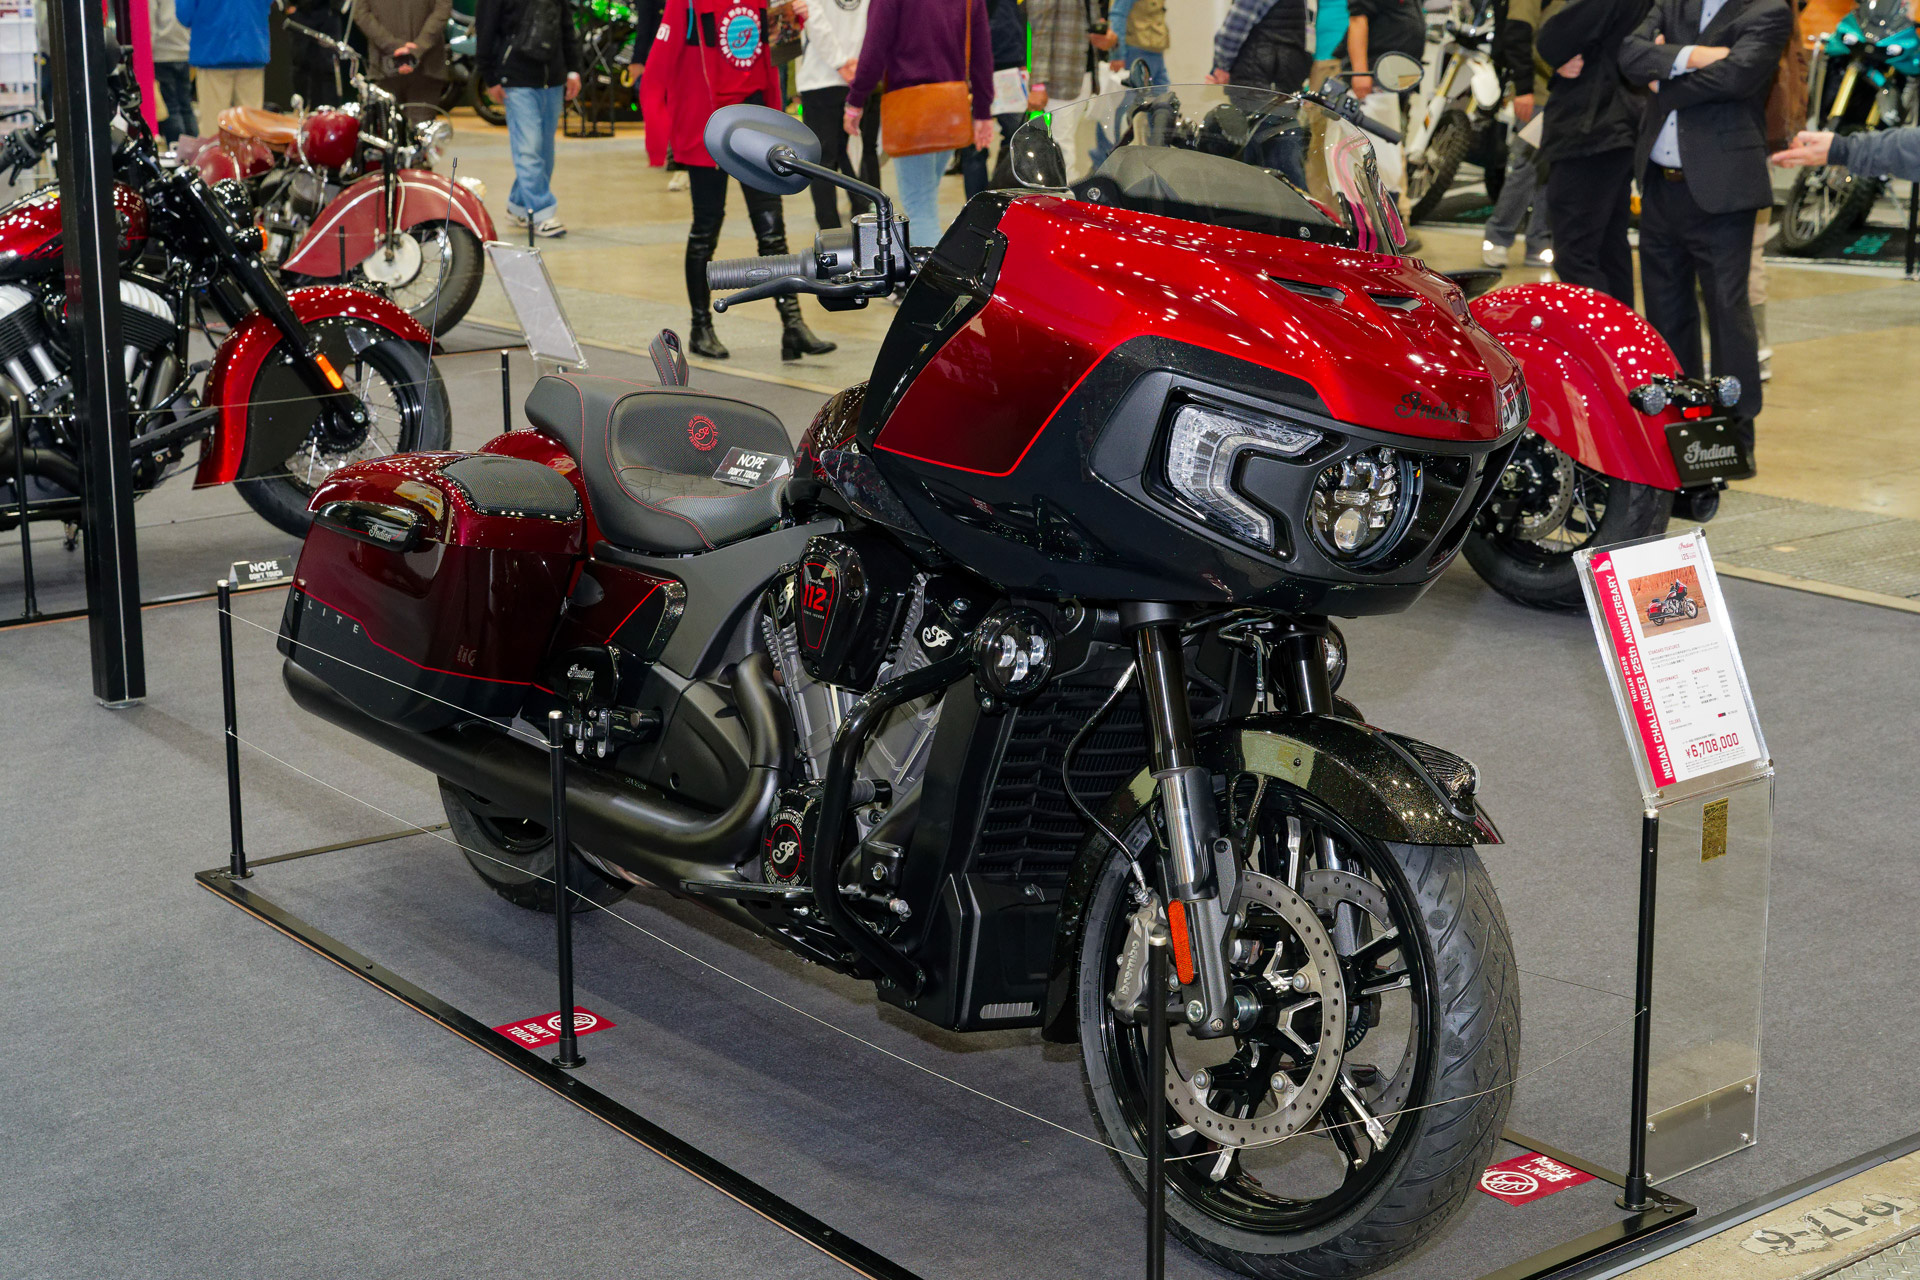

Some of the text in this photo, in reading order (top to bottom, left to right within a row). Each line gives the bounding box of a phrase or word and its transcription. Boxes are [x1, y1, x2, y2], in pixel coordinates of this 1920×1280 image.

[1394, 391, 1471, 424] Indian
[736, 454, 767, 469] NOPE
[1684, 441, 1738, 463] Indian
[727, 467, 745, 477] DON'T
[743, 469, 761, 480] TOUCH
[1689, 458, 1738, 470] MOTORCYCLE
[368, 524, 393, 542] Indian
[249, 560, 278, 573] NOPE
[803, 584, 827, 611] 112
[294, 592, 359, 634] ELITE
[567, 663, 595, 679] Indian
[1606, 575, 1673, 779] INDIAN CHALLENGER 125th ANNIVERSARY
[1626, 677, 1639, 702] INDIAN
[1685, 732, 1740, 758] ¥6,708,000
[1119, 940, 1140, 996] brembo
[506, 1026, 541, 1044] TOUCH
[523, 1022, 556, 1038] DON'T
[1517, 1164, 1562, 1183] DON'T
[1530, 1156, 1577, 1179] TOUCH
